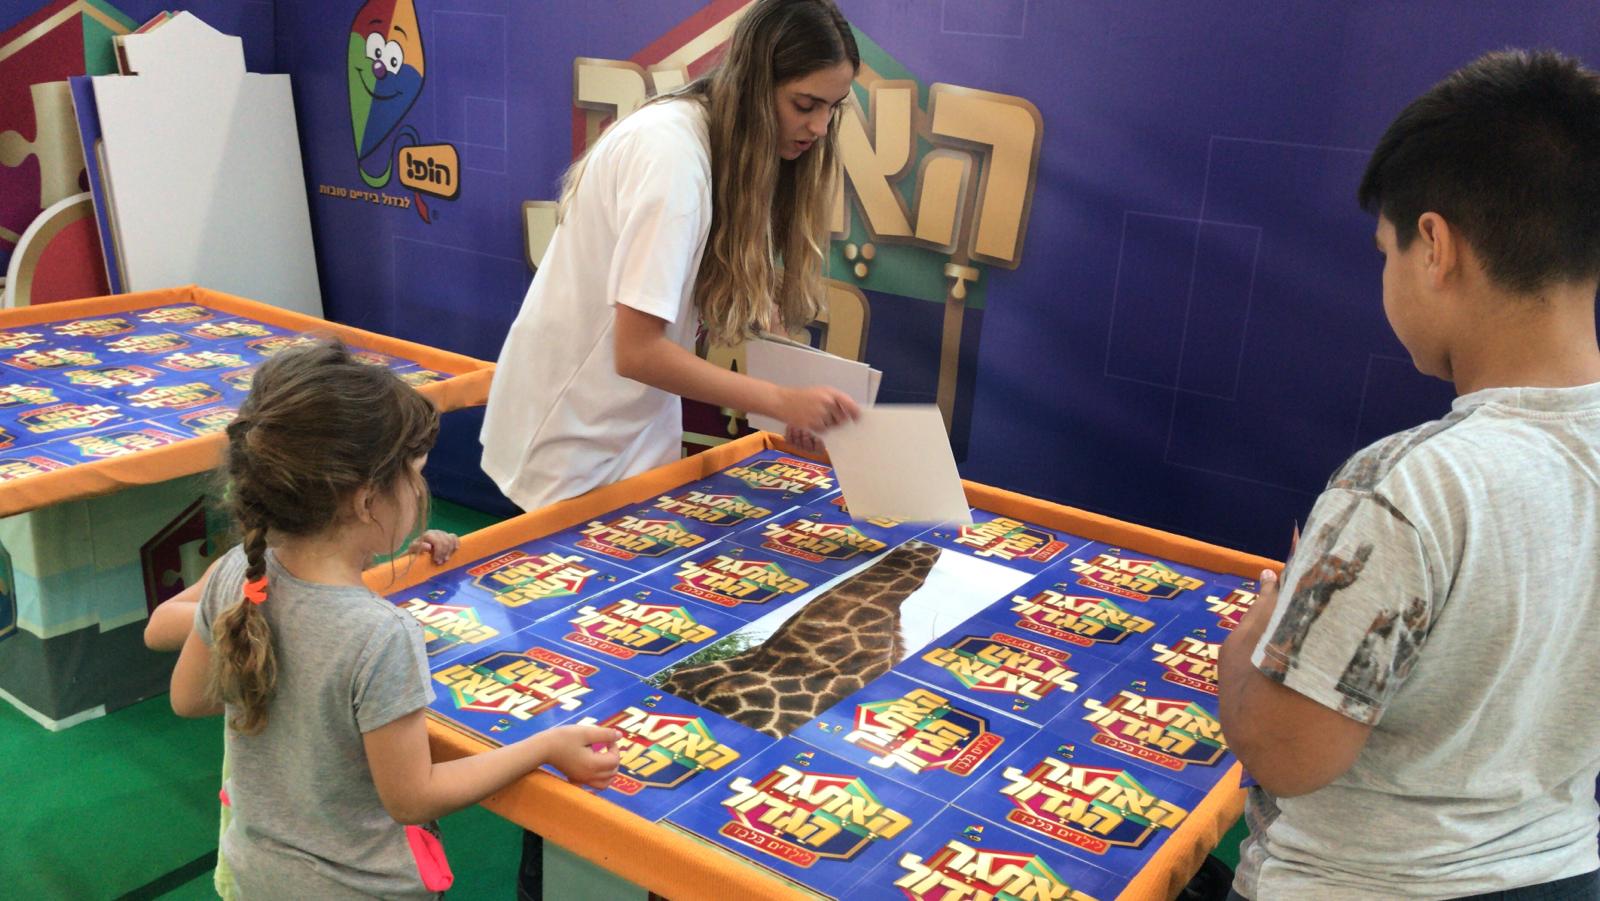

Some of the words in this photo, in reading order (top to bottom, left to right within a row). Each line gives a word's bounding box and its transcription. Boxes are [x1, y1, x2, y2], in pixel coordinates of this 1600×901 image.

[616, 706, 740, 771] האתגר
[720, 776, 842, 847] הגדול
[772, 765, 912, 841] האתגר
[999, 766, 1124, 835] הגדול
[1043, 756, 1190, 829] האתגר
